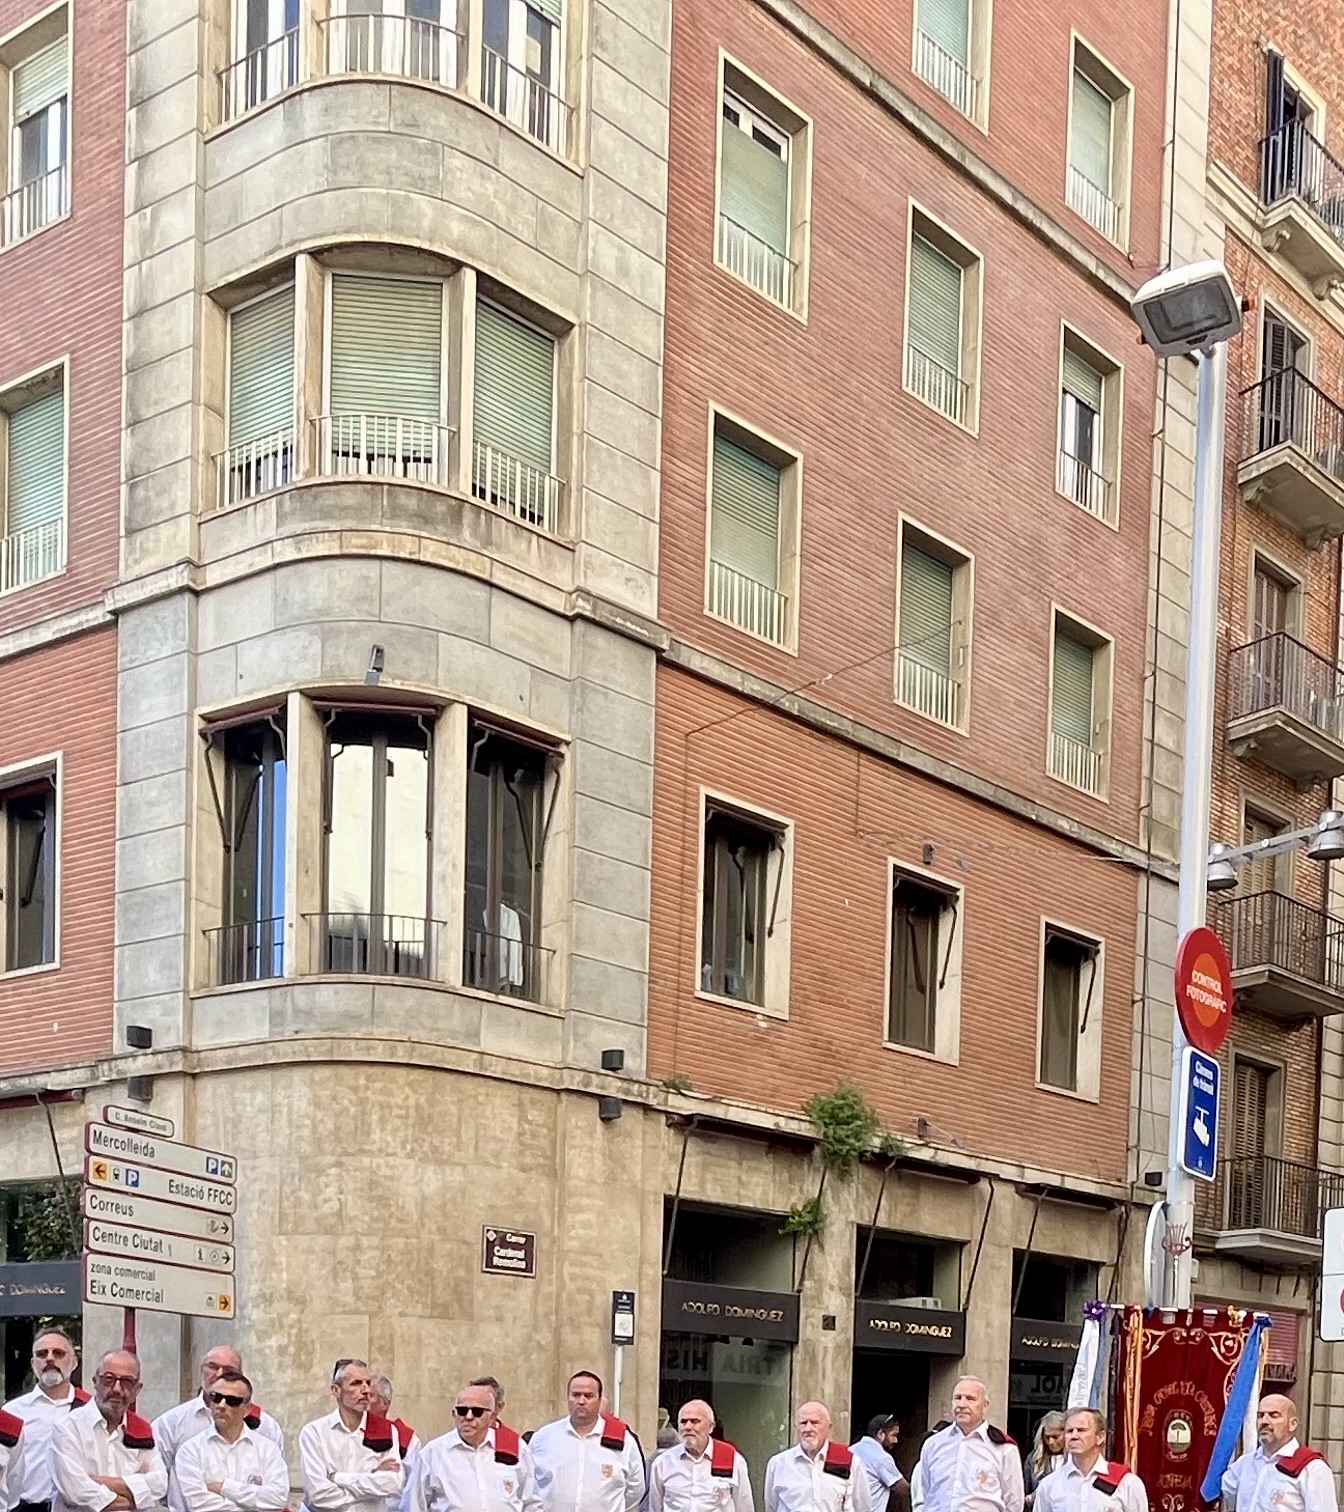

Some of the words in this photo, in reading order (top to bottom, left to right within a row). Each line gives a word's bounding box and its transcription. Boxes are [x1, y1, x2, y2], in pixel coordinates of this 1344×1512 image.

[92, 1129, 155, 1158] Mercolleida
[168, 1178, 205, 1201] Estació
[207, 1187, 233, 1206] FFCC
[89, 1194, 135, 1217] Correus
[92, 1225, 129, 1247] Centre
[132, 1233, 164, 1254] Ciutat
[90, 1263, 112, 1275] zona
[113, 1266, 156, 1281] comercial
[90, 1280, 107, 1296] Eix
[110, 1282, 164, 1303] Comercial
[681, 1301, 721, 1316] ADOLFO
[724, 1305, 784, 1321] DOMINGUEZ
[868, 1319, 902, 1333] ADOLFO
[904, 1322, 953, 1339] DOMINGUEZ
